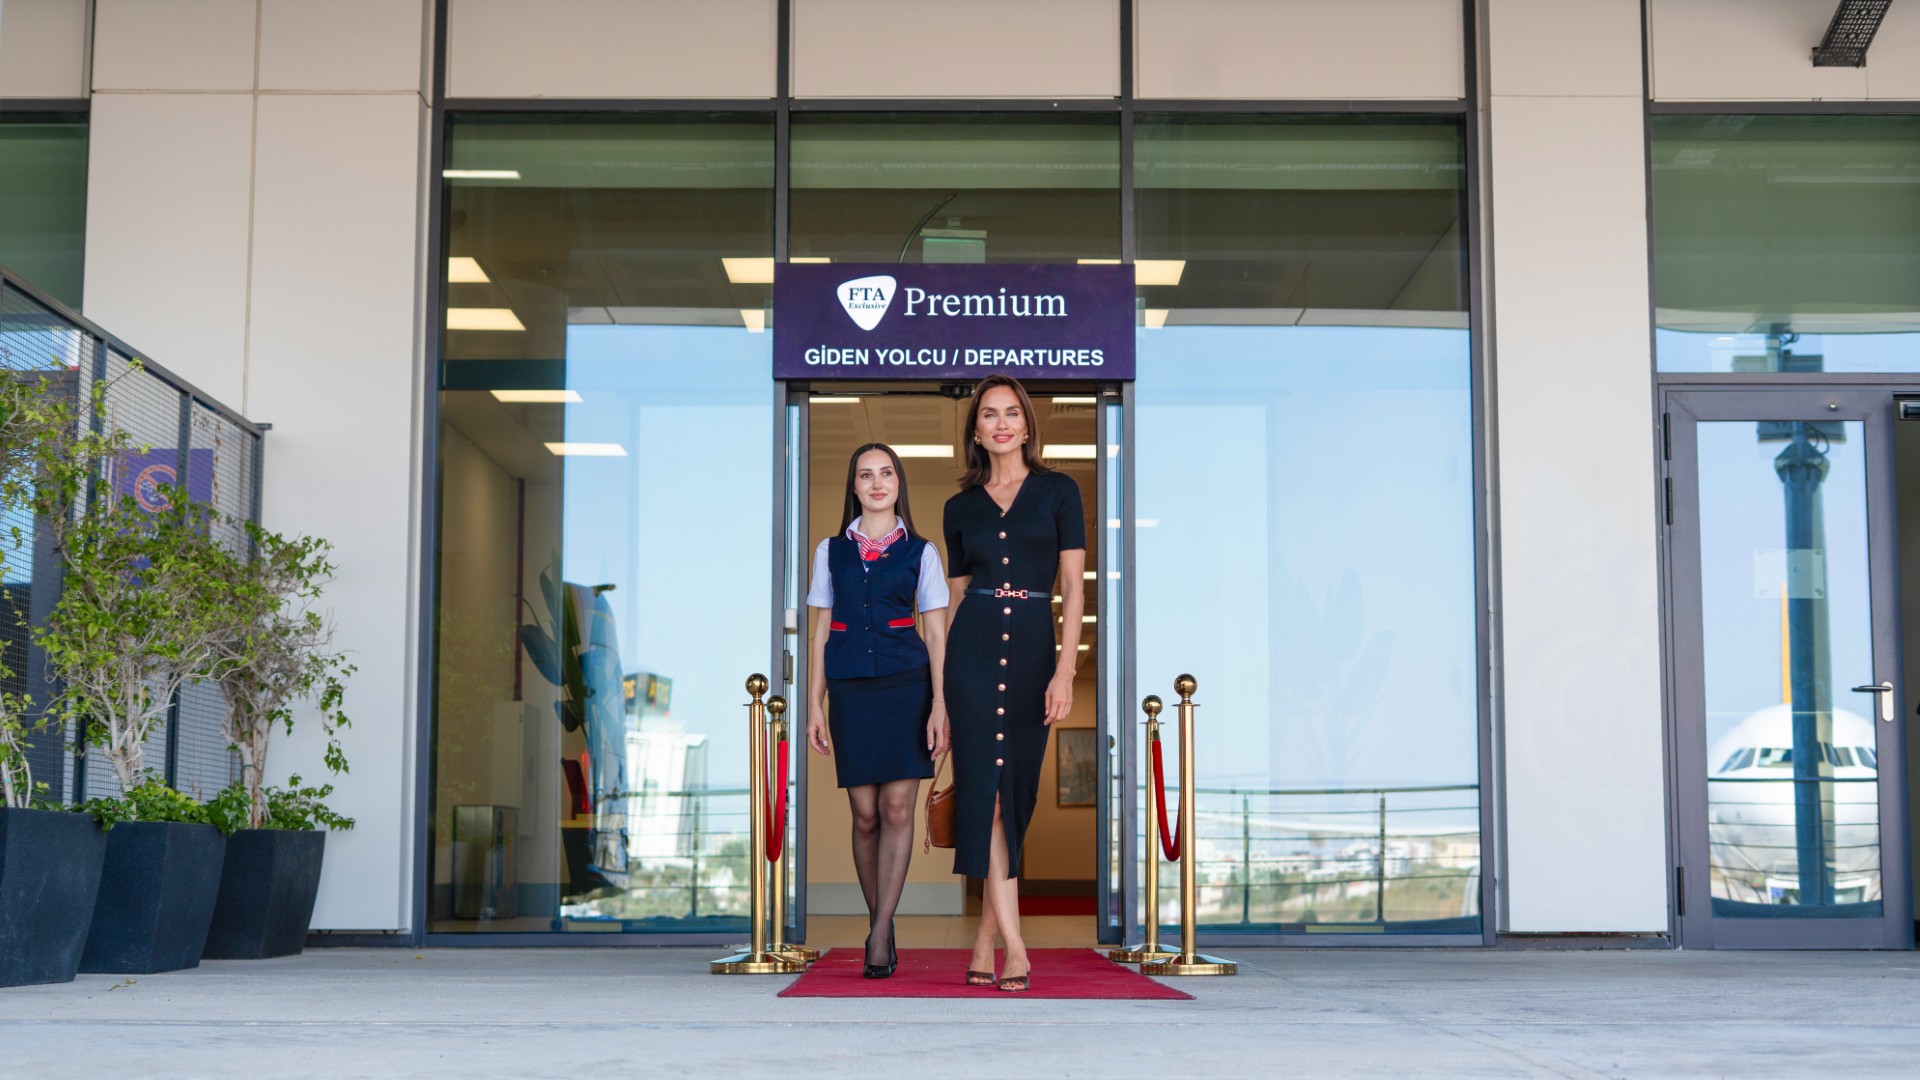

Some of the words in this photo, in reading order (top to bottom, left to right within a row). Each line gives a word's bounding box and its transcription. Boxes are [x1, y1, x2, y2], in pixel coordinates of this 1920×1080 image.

[848, 287, 886, 301] FTA
[904, 288, 1068, 317] Premium
[848, 302, 887, 310] Exclusive
[804, 344, 869, 367] GİDEN
[875, 348, 947, 366] YOLCU
[952, 348, 959, 366] /
[965, 348, 1104, 366] DEPARTURES
